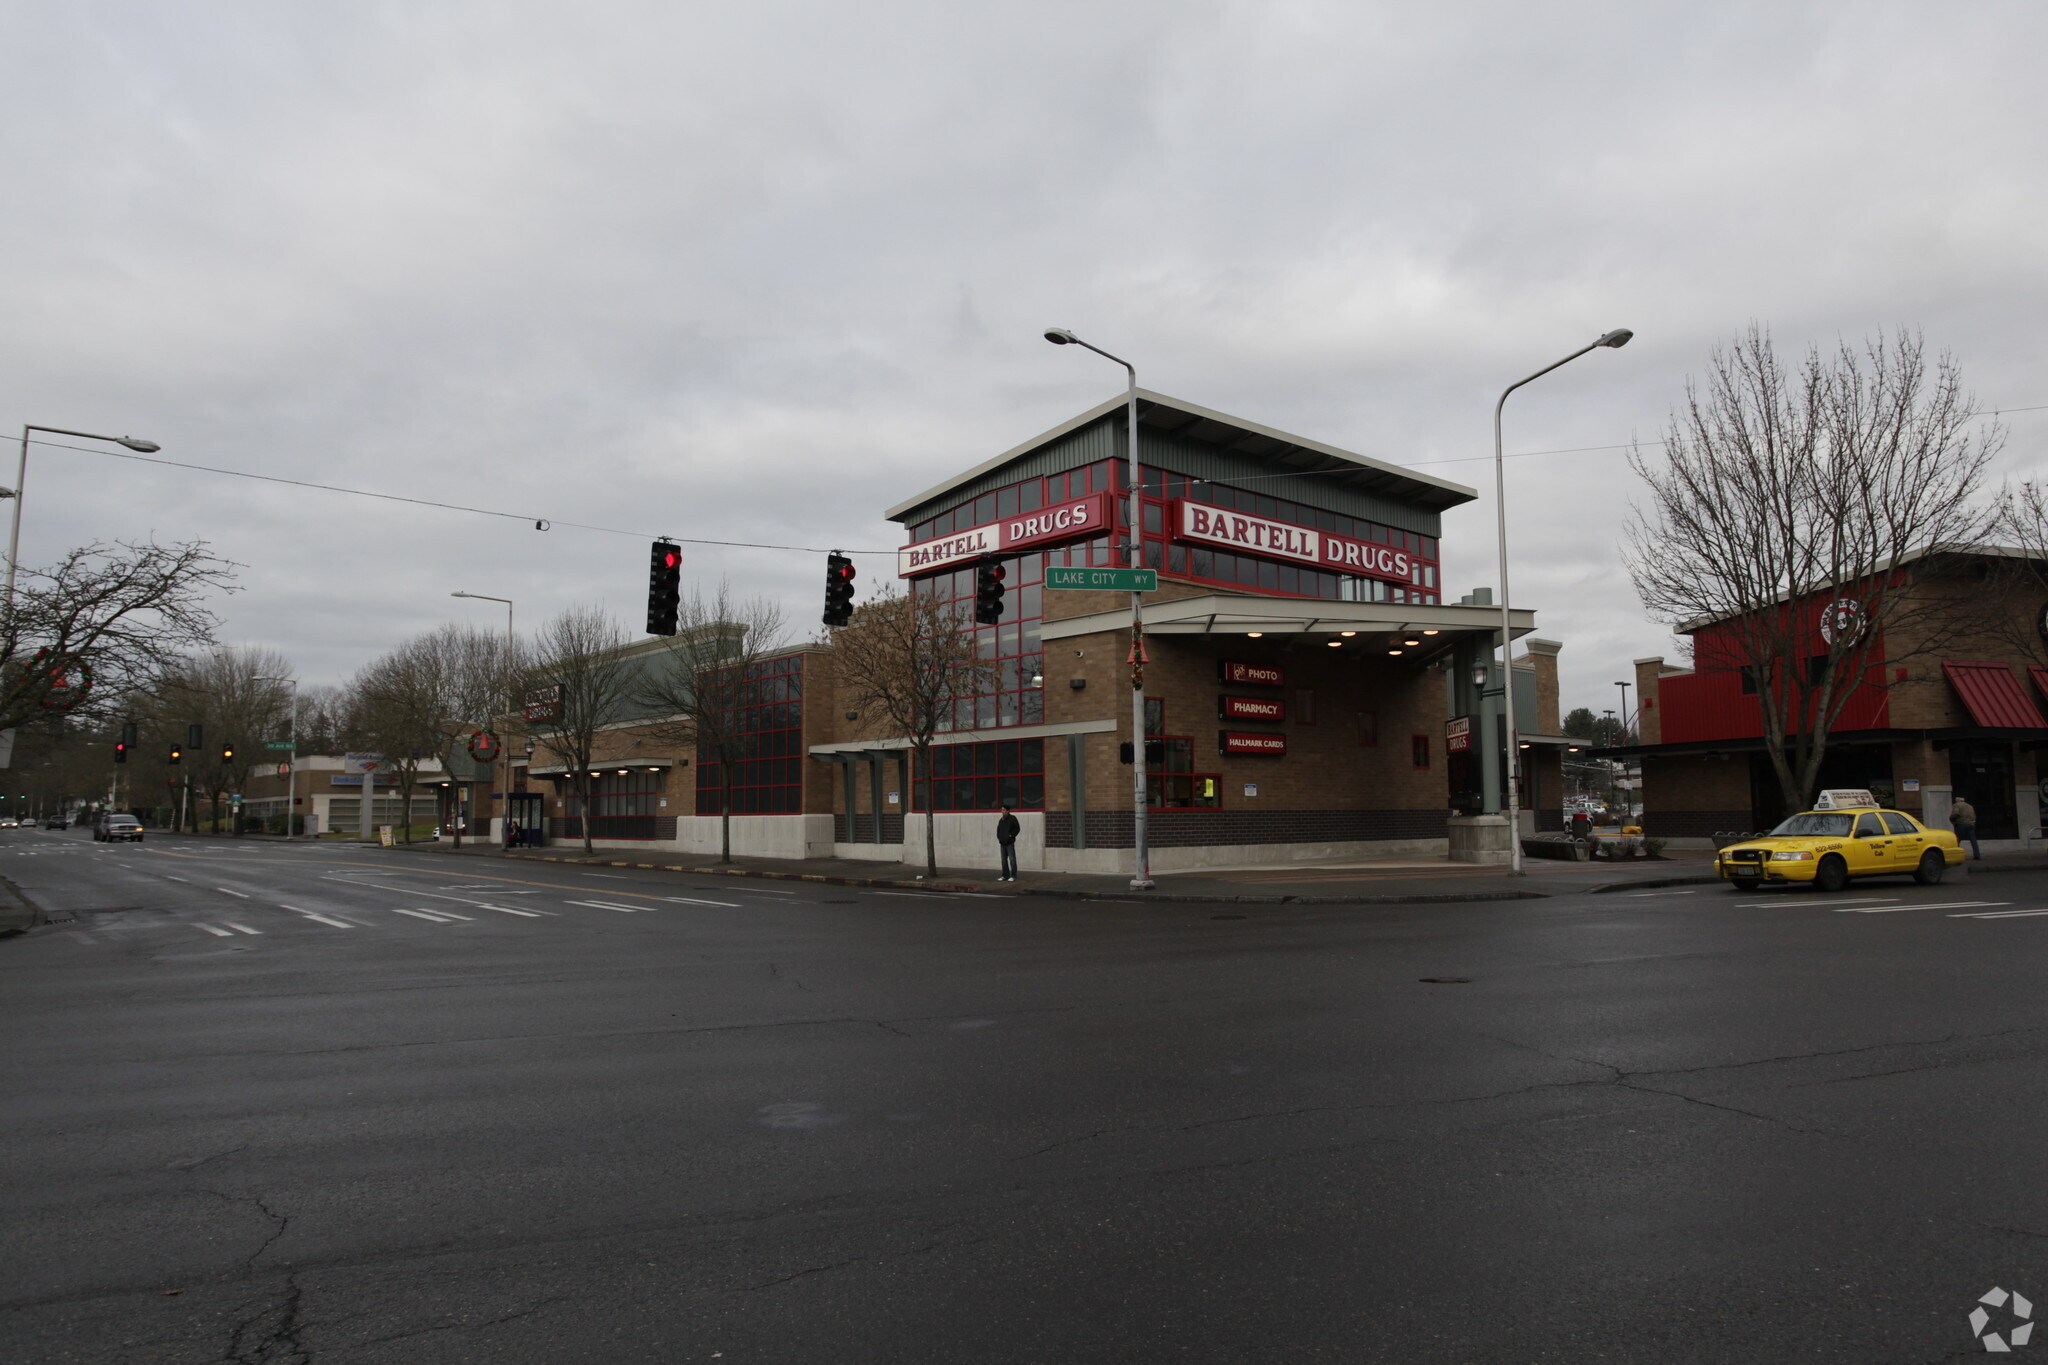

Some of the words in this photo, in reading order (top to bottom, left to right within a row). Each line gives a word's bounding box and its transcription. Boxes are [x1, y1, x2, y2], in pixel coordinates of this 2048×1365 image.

[909, 532, 987, 568] BARTELL
[1010, 504, 1088, 541] DRUGS
[1191, 507, 1313, 557] BARTELL
[1325, 537, 1409, 577] DRUGS
[1055, 572, 1084, 584] LAKE
[1091, 572, 1117, 585] CITY
[1134, 575, 1148, 584] WY
[1248, 668, 1278, 681] PHOTO
[1234, 702, 1278, 714] PHARMACY
[1448, 719, 1467, 735] BARTELL
[1229, 738, 1263, 748] HALLMARK
[1263, 740, 1284, 749] CARDS
[1450, 736, 1466, 750] DRUGS
